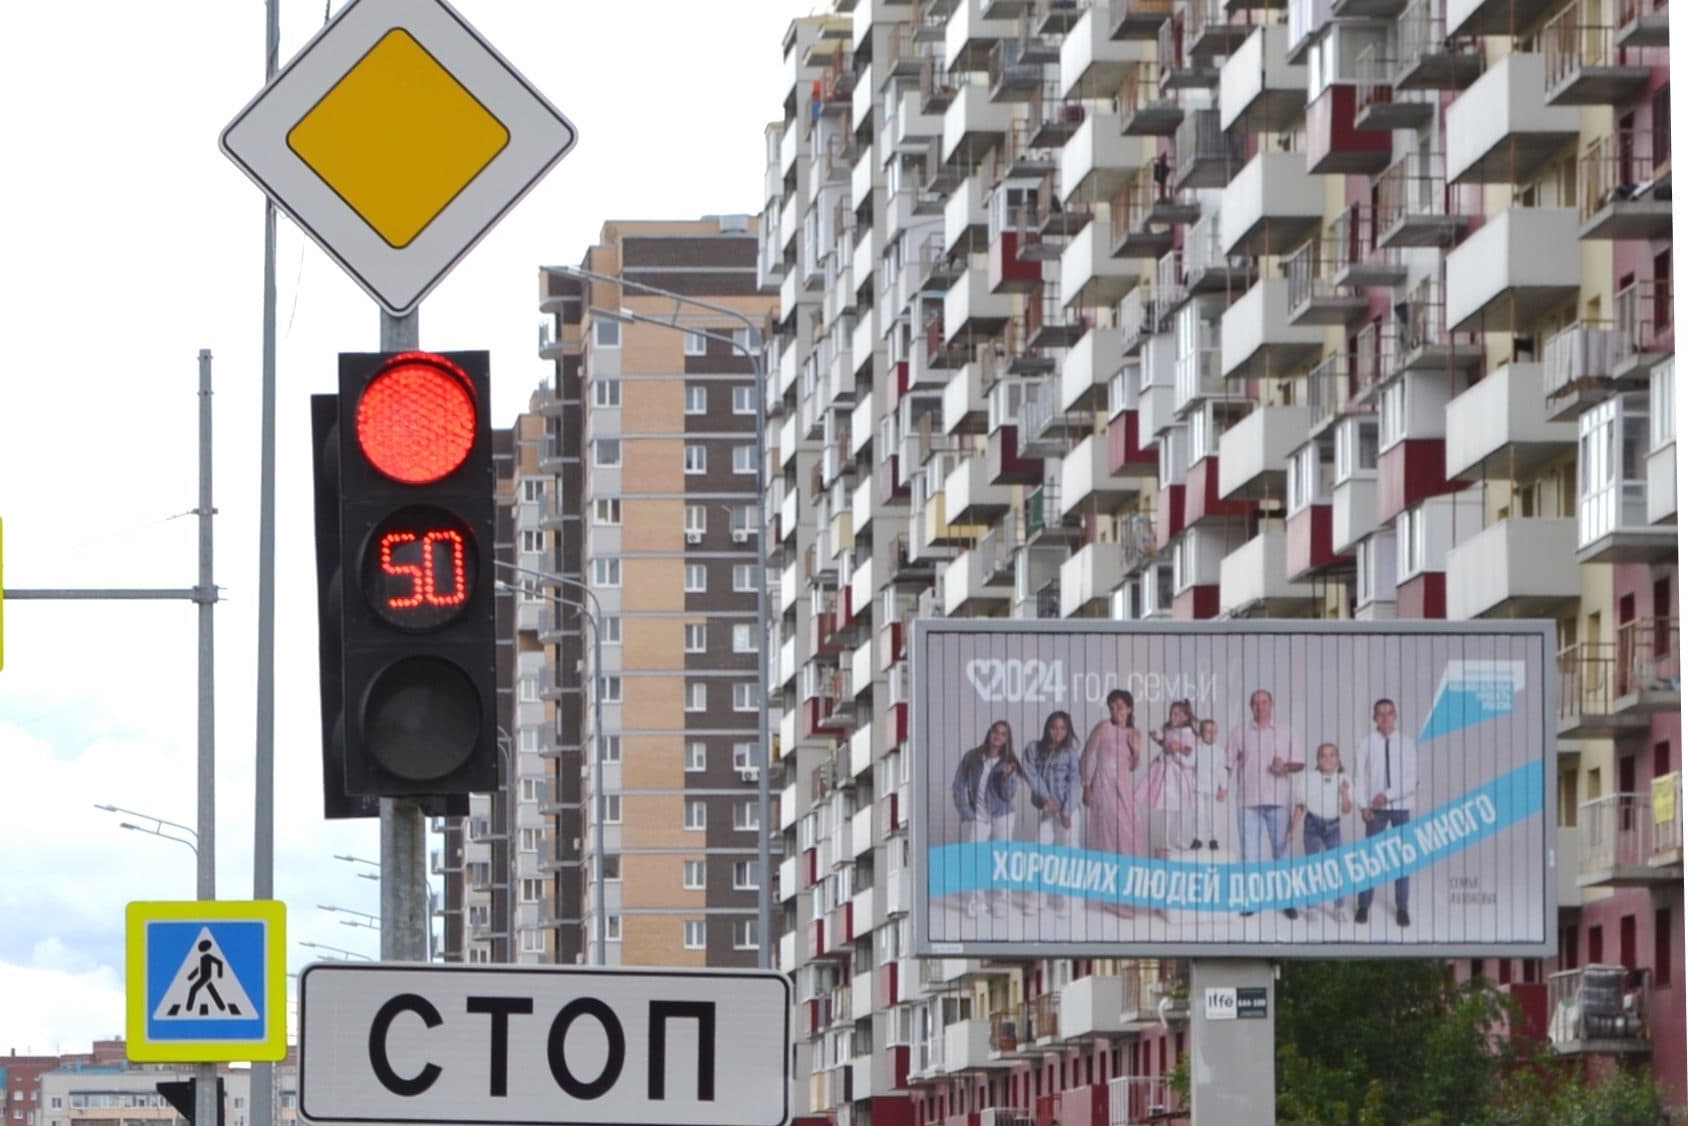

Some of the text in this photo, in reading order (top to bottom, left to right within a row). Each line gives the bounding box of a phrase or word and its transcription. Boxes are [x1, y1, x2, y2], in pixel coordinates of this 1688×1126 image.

[381, 529, 465, 608] 50
[992, 794, 1497, 907] ХОРОШИХ ЛЮДЕЙ ДОЛЖНО БЫТЬ МНОГО
[369, 992, 716, 1102] СТОП
